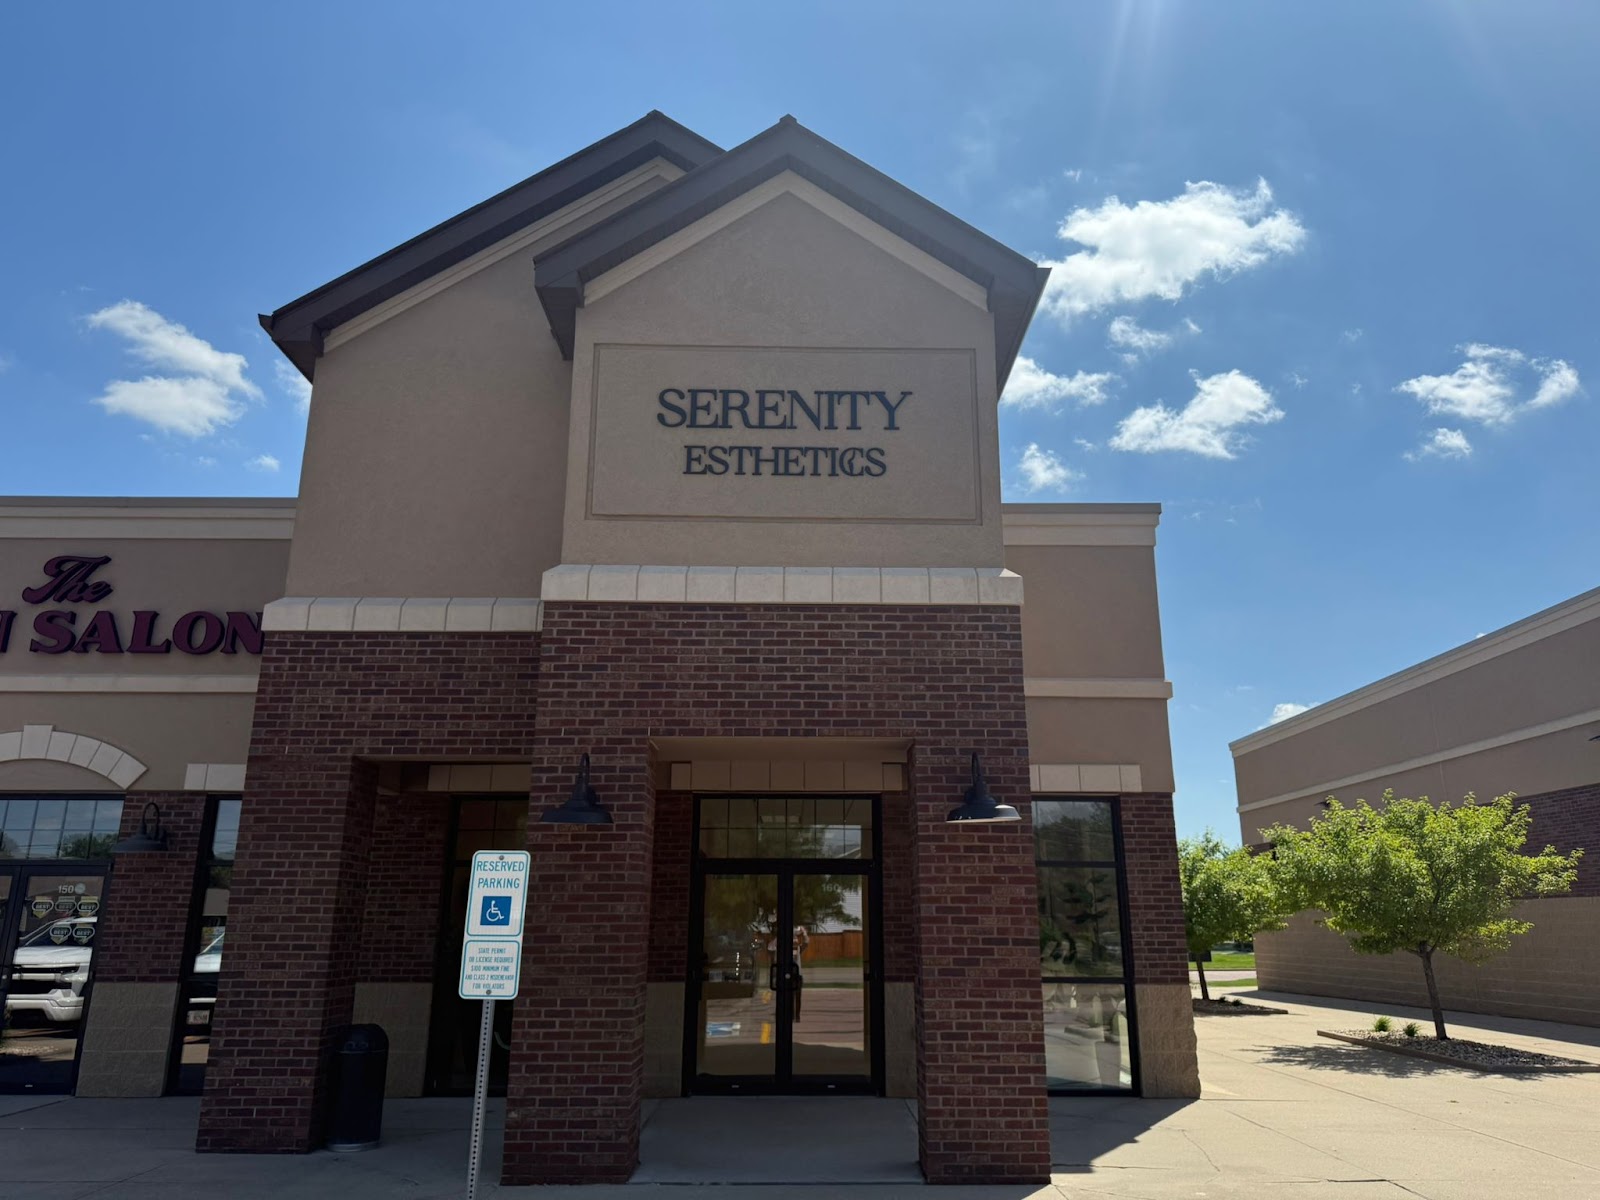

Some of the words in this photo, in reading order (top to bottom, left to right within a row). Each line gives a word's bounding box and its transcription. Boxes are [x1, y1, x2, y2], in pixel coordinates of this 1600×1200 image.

[657, 388, 913, 431] SERENITY
[683, 445, 887, 477] ESTHETICS
[22, 555, 113, 604] The
[29, 610, 265, 655] SALON
[477, 860, 524, 872] RESERVED
[57, 885, 74, 894] 150
[477, 878, 520, 889] PARKING
[821, 883, 840, 892] 160
